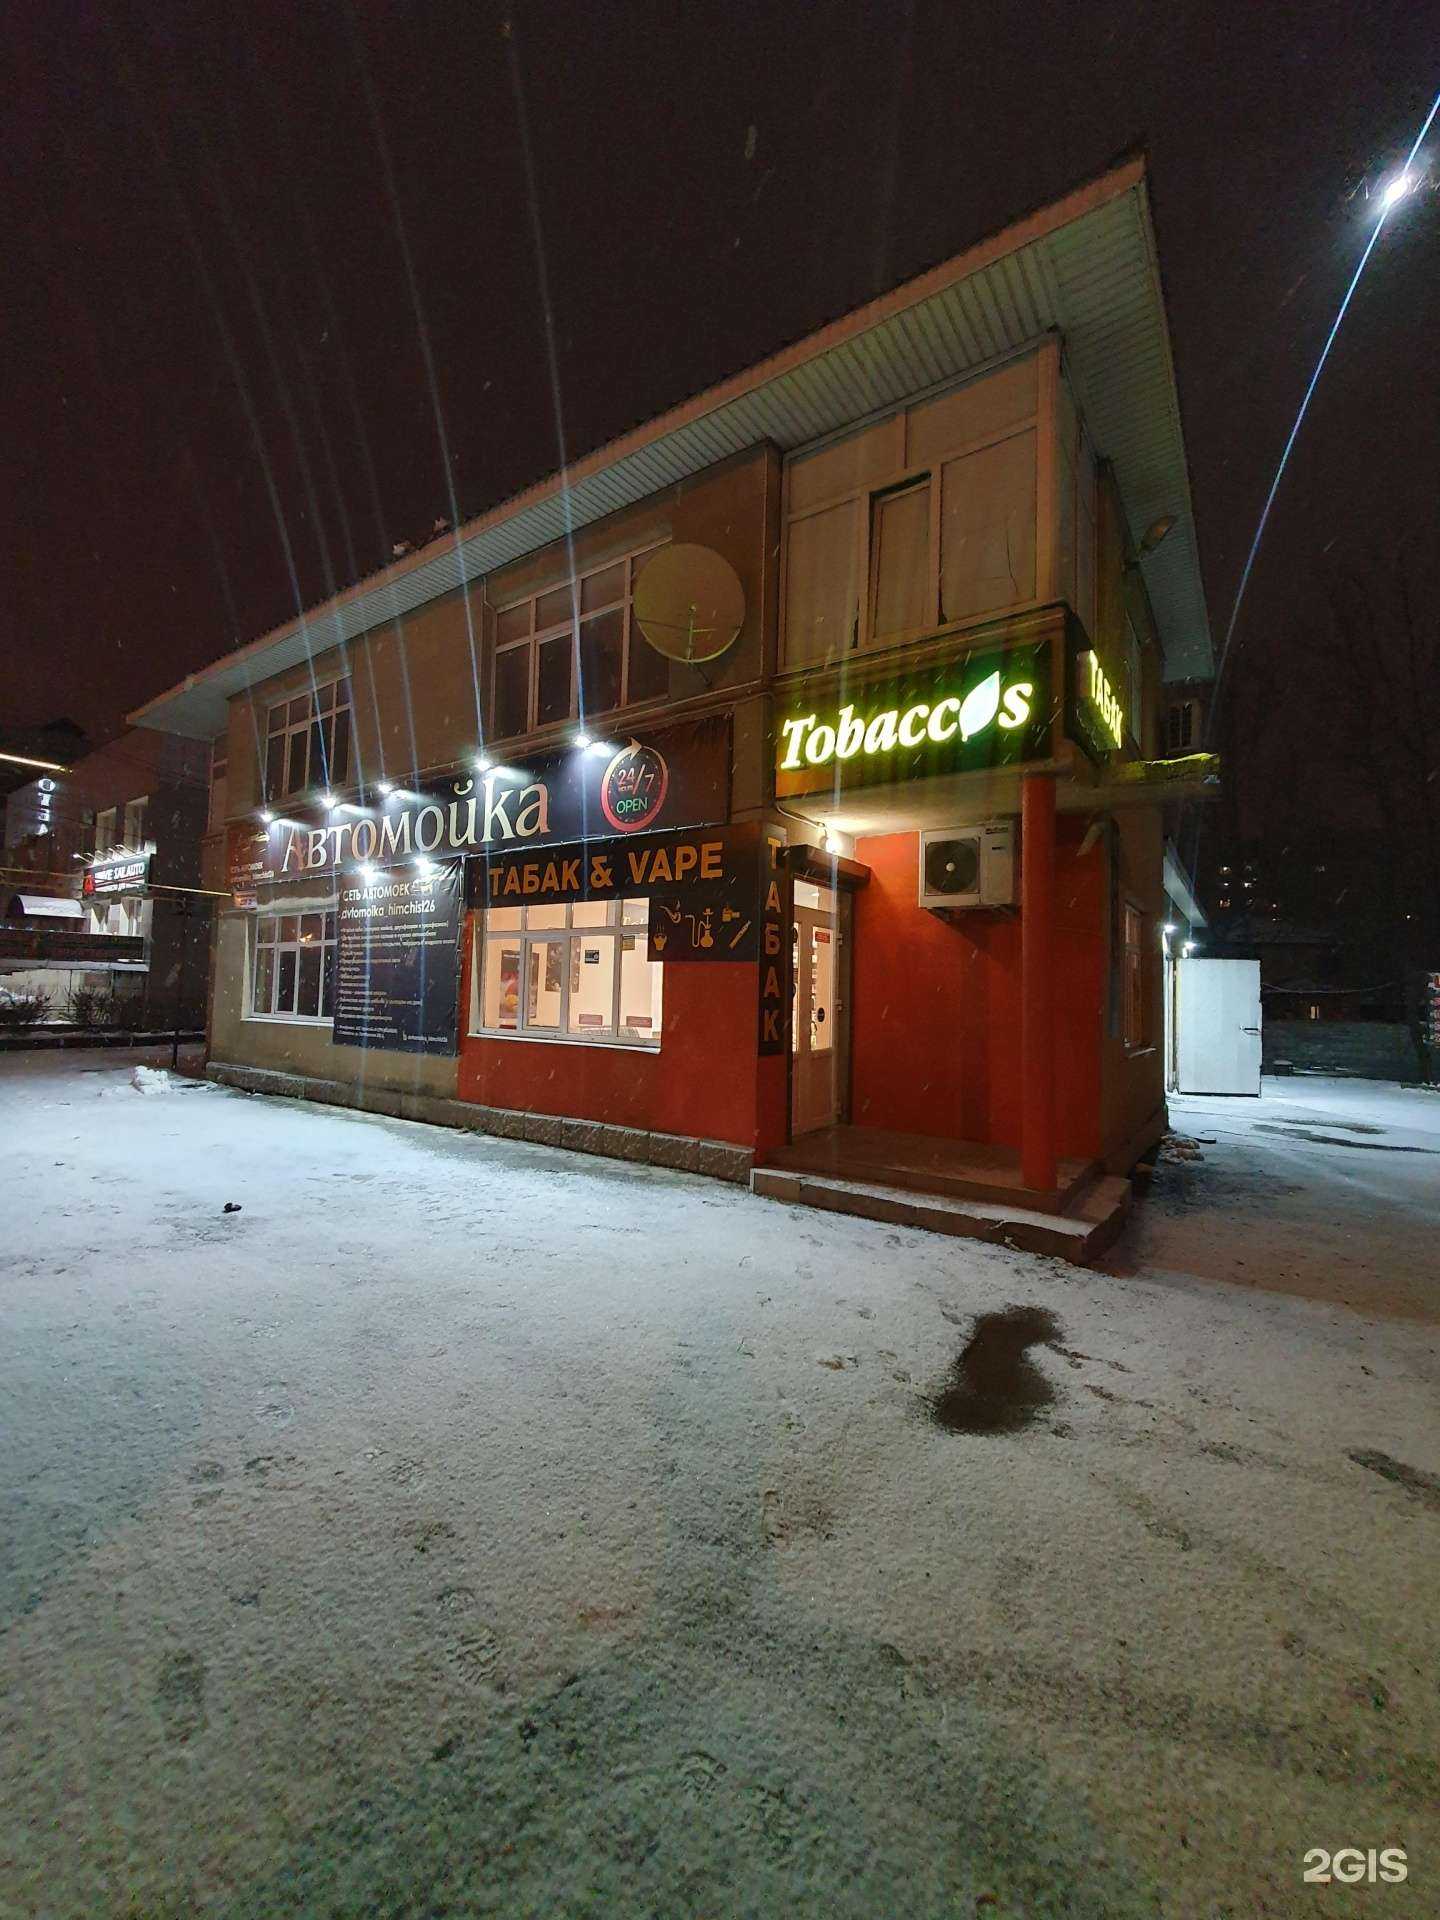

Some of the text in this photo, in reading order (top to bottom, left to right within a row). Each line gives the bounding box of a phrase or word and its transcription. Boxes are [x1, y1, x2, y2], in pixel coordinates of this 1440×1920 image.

[618, 763, 655, 796] 24/7
[616, 797, 648, 814] OPEN
[488, 842, 724, 897] ТАБАК & VAPE
[342, 882, 411, 902] СЕТЬ АВТОМОЕК
[763, 836, 782, 1041] ТАБАК
